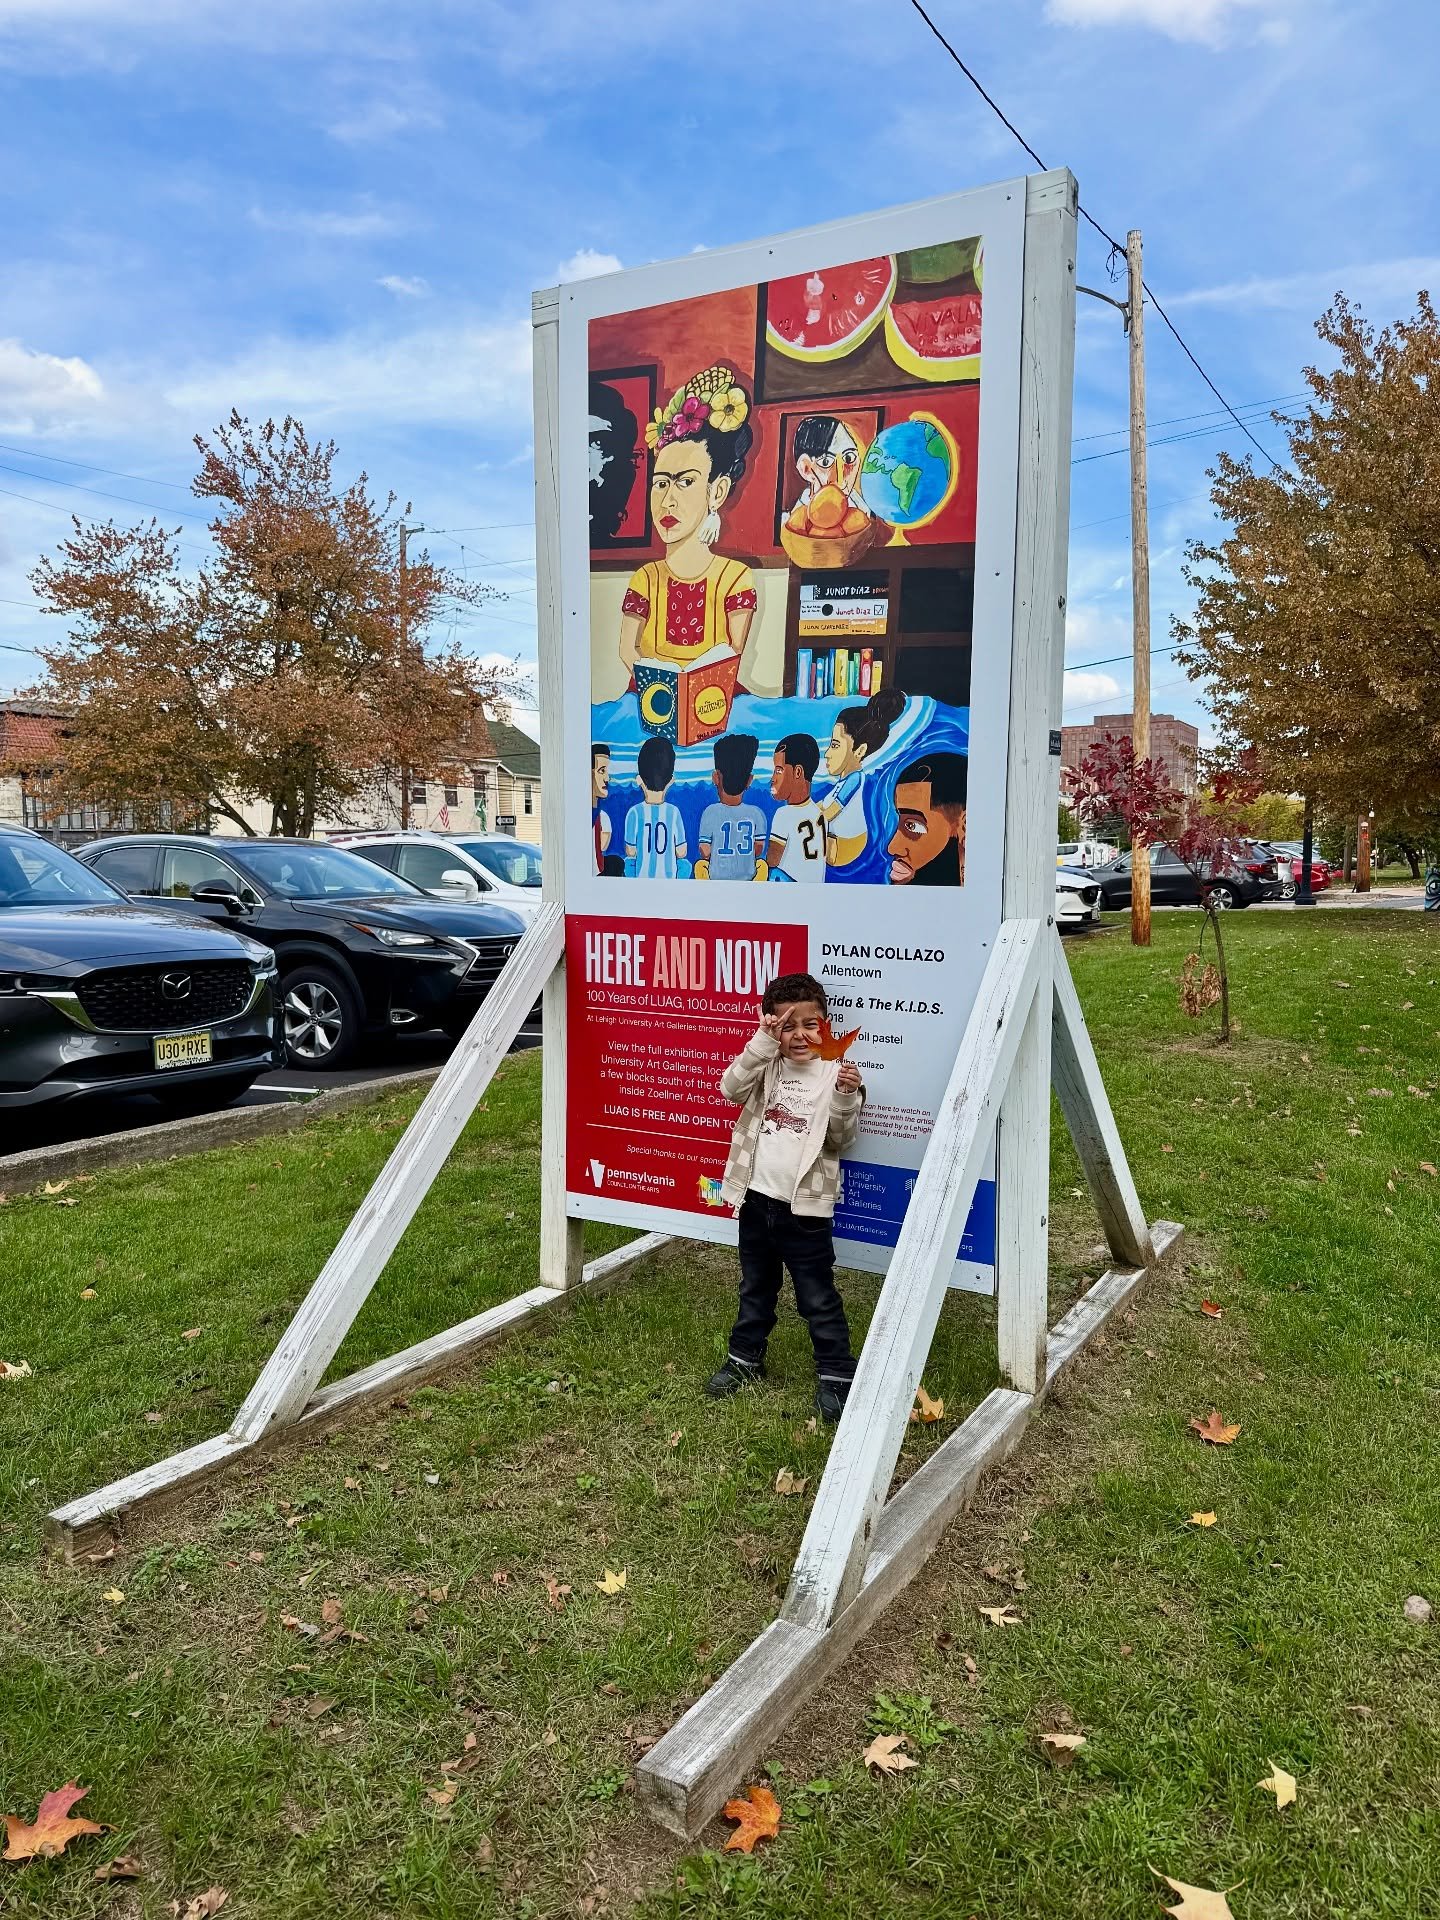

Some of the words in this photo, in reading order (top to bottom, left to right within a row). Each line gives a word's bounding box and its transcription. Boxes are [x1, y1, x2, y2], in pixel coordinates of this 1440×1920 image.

[825, 586, 850, 597] JUNOT
[645, 821, 668, 855] 10
[717, 819, 754, 857] 13
[797, 814, 827, 860] 21
[822, 943, 871, 959] DYLAN
[874, 946, 945, 963] COLLAZO
[585, 931, 646, 987] HERE
[652, 935, 707, 991] AND
[715, 938, 782, 996] NOW
[821, 963, 882, 979] Allentown
[586, 989, 606, 1002] 100
[607, 990, 637, 1006] Years
[638, 993, 648, 1006] of
[650, 994, 685, 1011] LUAG,
[687, 998, 708, 1011] 100
[709, 999, 741, 1014] Local
[855, 996, 865, 1009] &
[868, 997, 892, 1011] The
[894, 999, 944, 1015] K.I.D.S.
[595, 1015, 617, 1026] Lehigh
[618, 1016, 653, 1029] University
[653, 1020, 665, 1029] Art
[666, 1021, 697, 1032] Galleries
[698, 1024, 727, 1036] through
[728, 1027, 745, 1038] May
[827, 1012, 844, 1023] 018
[858, 1031, 870, 1042] oil
[872, 1032, 903, 1045] pastel
[158, 1042, 180, 1060] U30
[186, 1038, 208, 1056] RXE
[608, 1040, 630, 1052] View
[631, 1042, 646, 1054] the
[647, 1044, 662, 1055] full
[664, 1047, 708, 1060] exhibition
[710, 1051, 720, 1061] at
[601, 1053, 645, 1070] University
[646, 1058, 661, 1070] Art
[662, 1060, 705, 1076] Galleries,
[600, 1070, 606, 1078] a
[607, 1068, 624, 1080] few
[626, 1070, 655, 1083] blocks
[657, 1075, 683, 1087] south
[684, 1077, 695, 1088] of
[696, 1079, 712, 1090] the
[619, 1084, 645, 1097] inside
[647, 1087, 685, 1101] Zoellner
[686, 1092, 706, 1104] Arts
[604, 1103, 630, 1116] LUAG
[631, 1107, 641, 1118] IS
[642, 1108, 666, 1121] FREE
[667, 1112, 690, 1124] AND
[692, 1115, 720, 1129] OPEN
[722, 1119, 737, 1130] TO
[900, 1108, 921, 1116] watch
[892, 1131, 917, 1140] student
[909, 1124, 932, 1134] Lehigh
[626, 1144, 652, 1155] Special
[652, 1148, 676, 1159] thanks
[677, 1151, 685, 1160] to
[686, 1154, 699, 1162] our
[607, 1168, 675, 1187] pennsylvania
[848, 1169, 875, 1182] Lehigh
[848, 1178, 887, 1194] University
[848, 1188, 860, 1198] Art
[848, 1197, 882, 1211] Galleries
